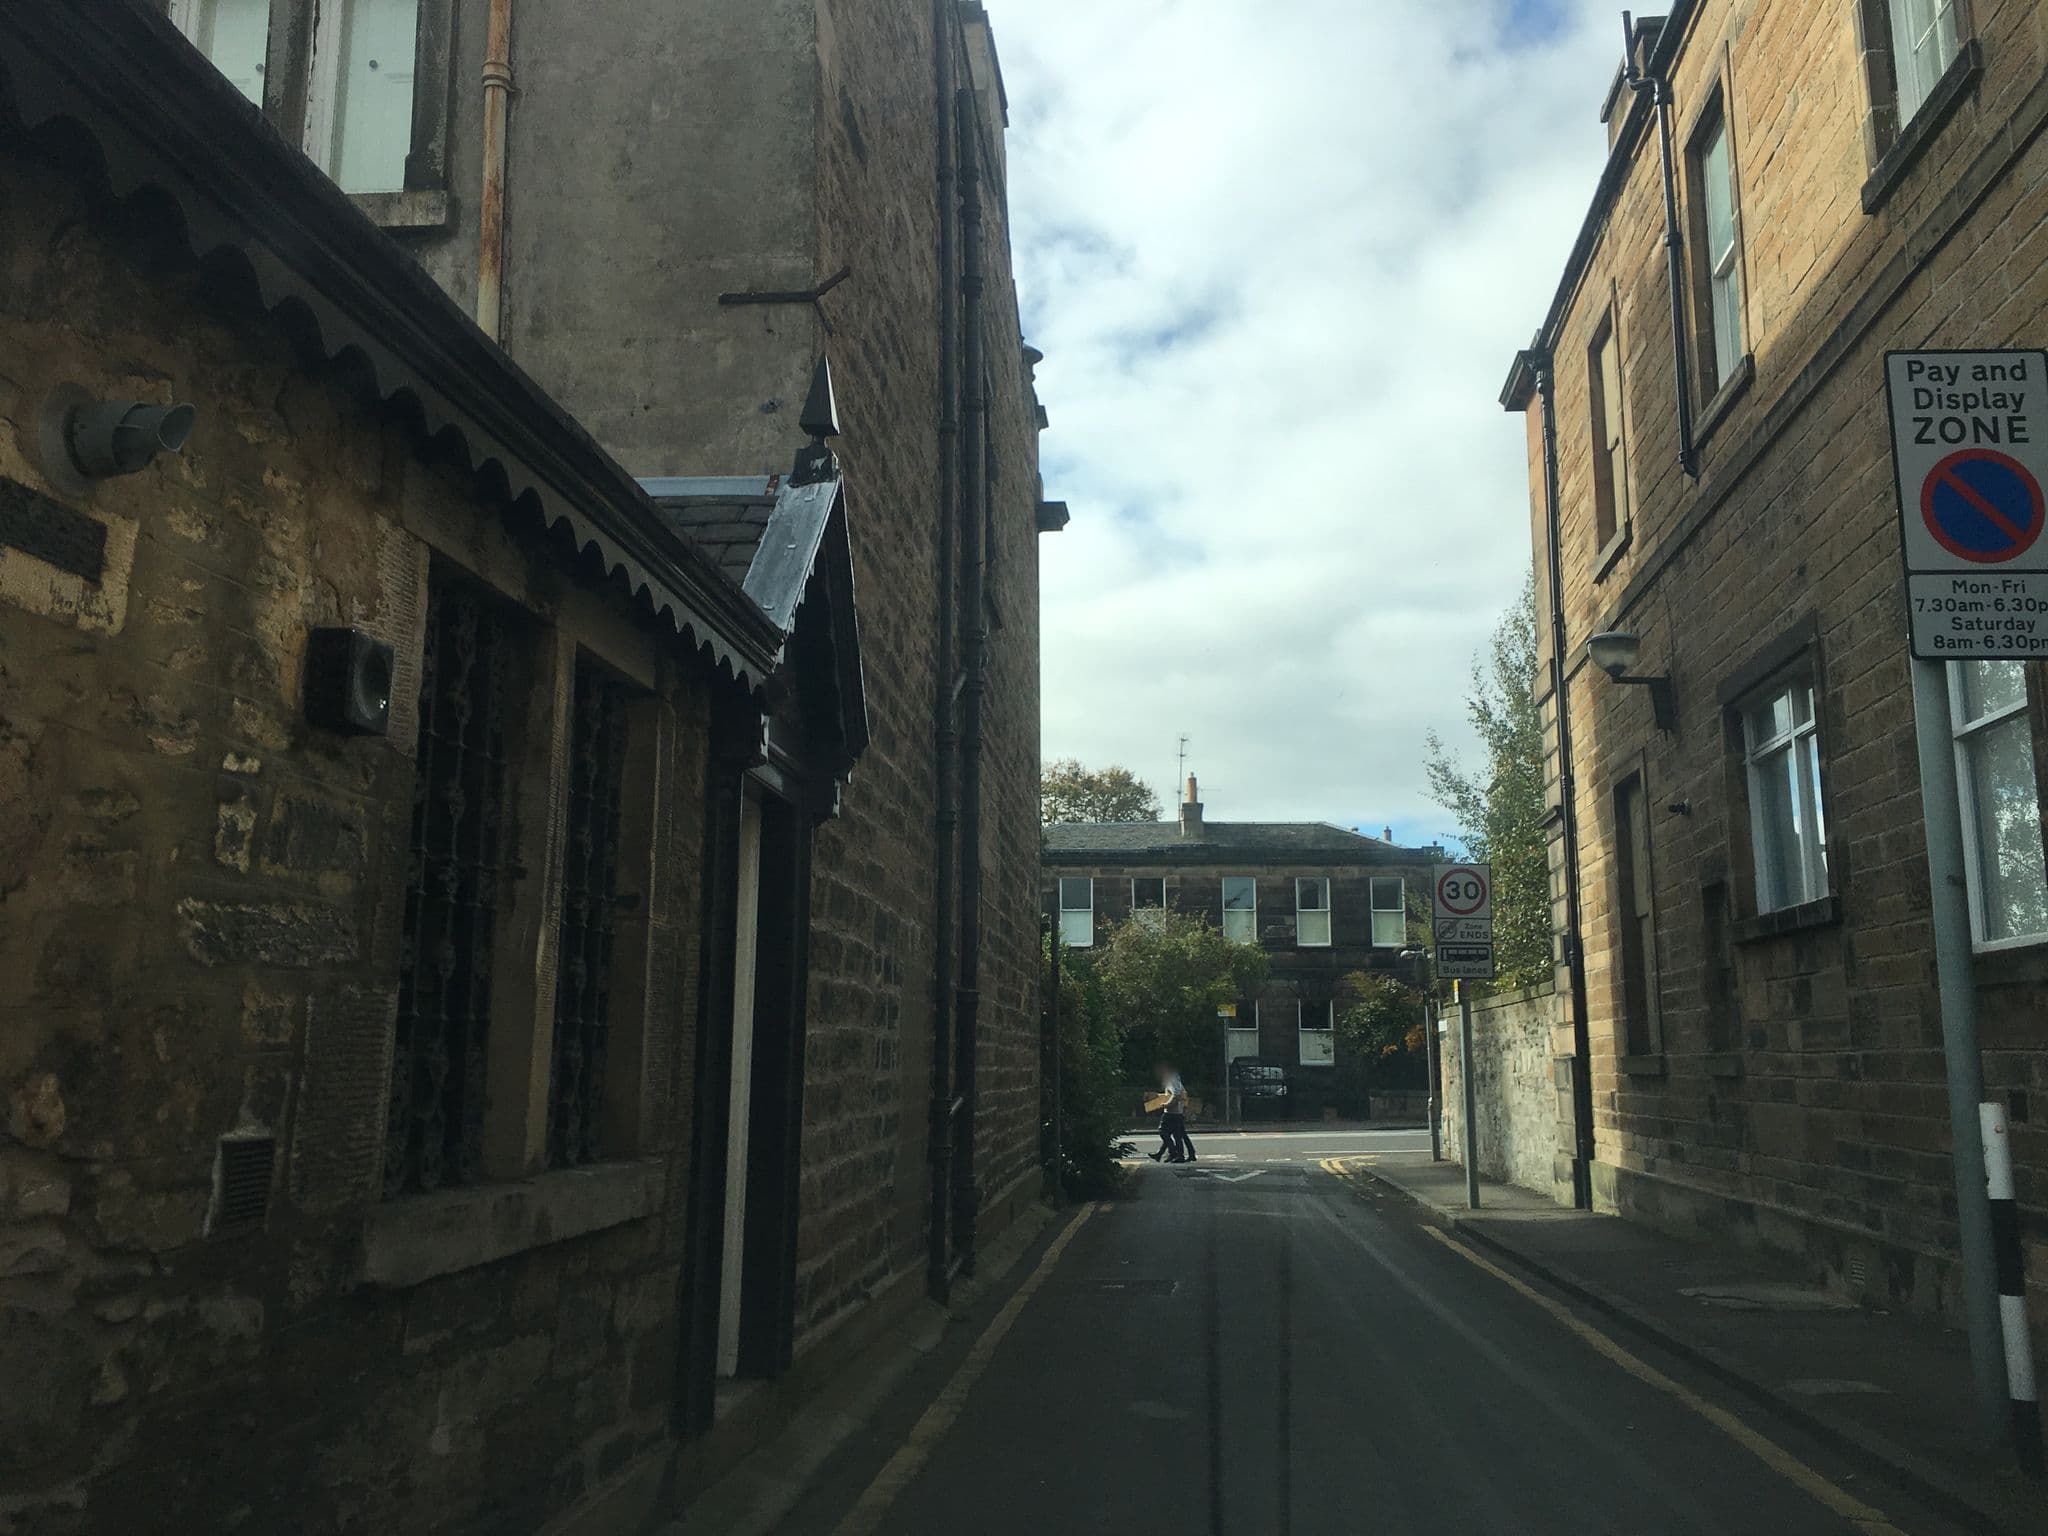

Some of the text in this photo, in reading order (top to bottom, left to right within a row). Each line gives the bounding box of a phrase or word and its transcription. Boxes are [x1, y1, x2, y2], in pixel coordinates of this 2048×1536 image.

[1907, 359, 2027, 386] Pay and
[1914, 388, 2025, 413] Display
[1913, 416, 2030, 444] ZONE
[1952, 580, 2026, 594] Mon-Fri
[1915, 598, 2048, 614] 7.30am-6.30p
[1952, 617, 2035, 633] Saturday
[1446, 881, 1480, 900] 30
[1443, 966, 1460, 974] Bus
